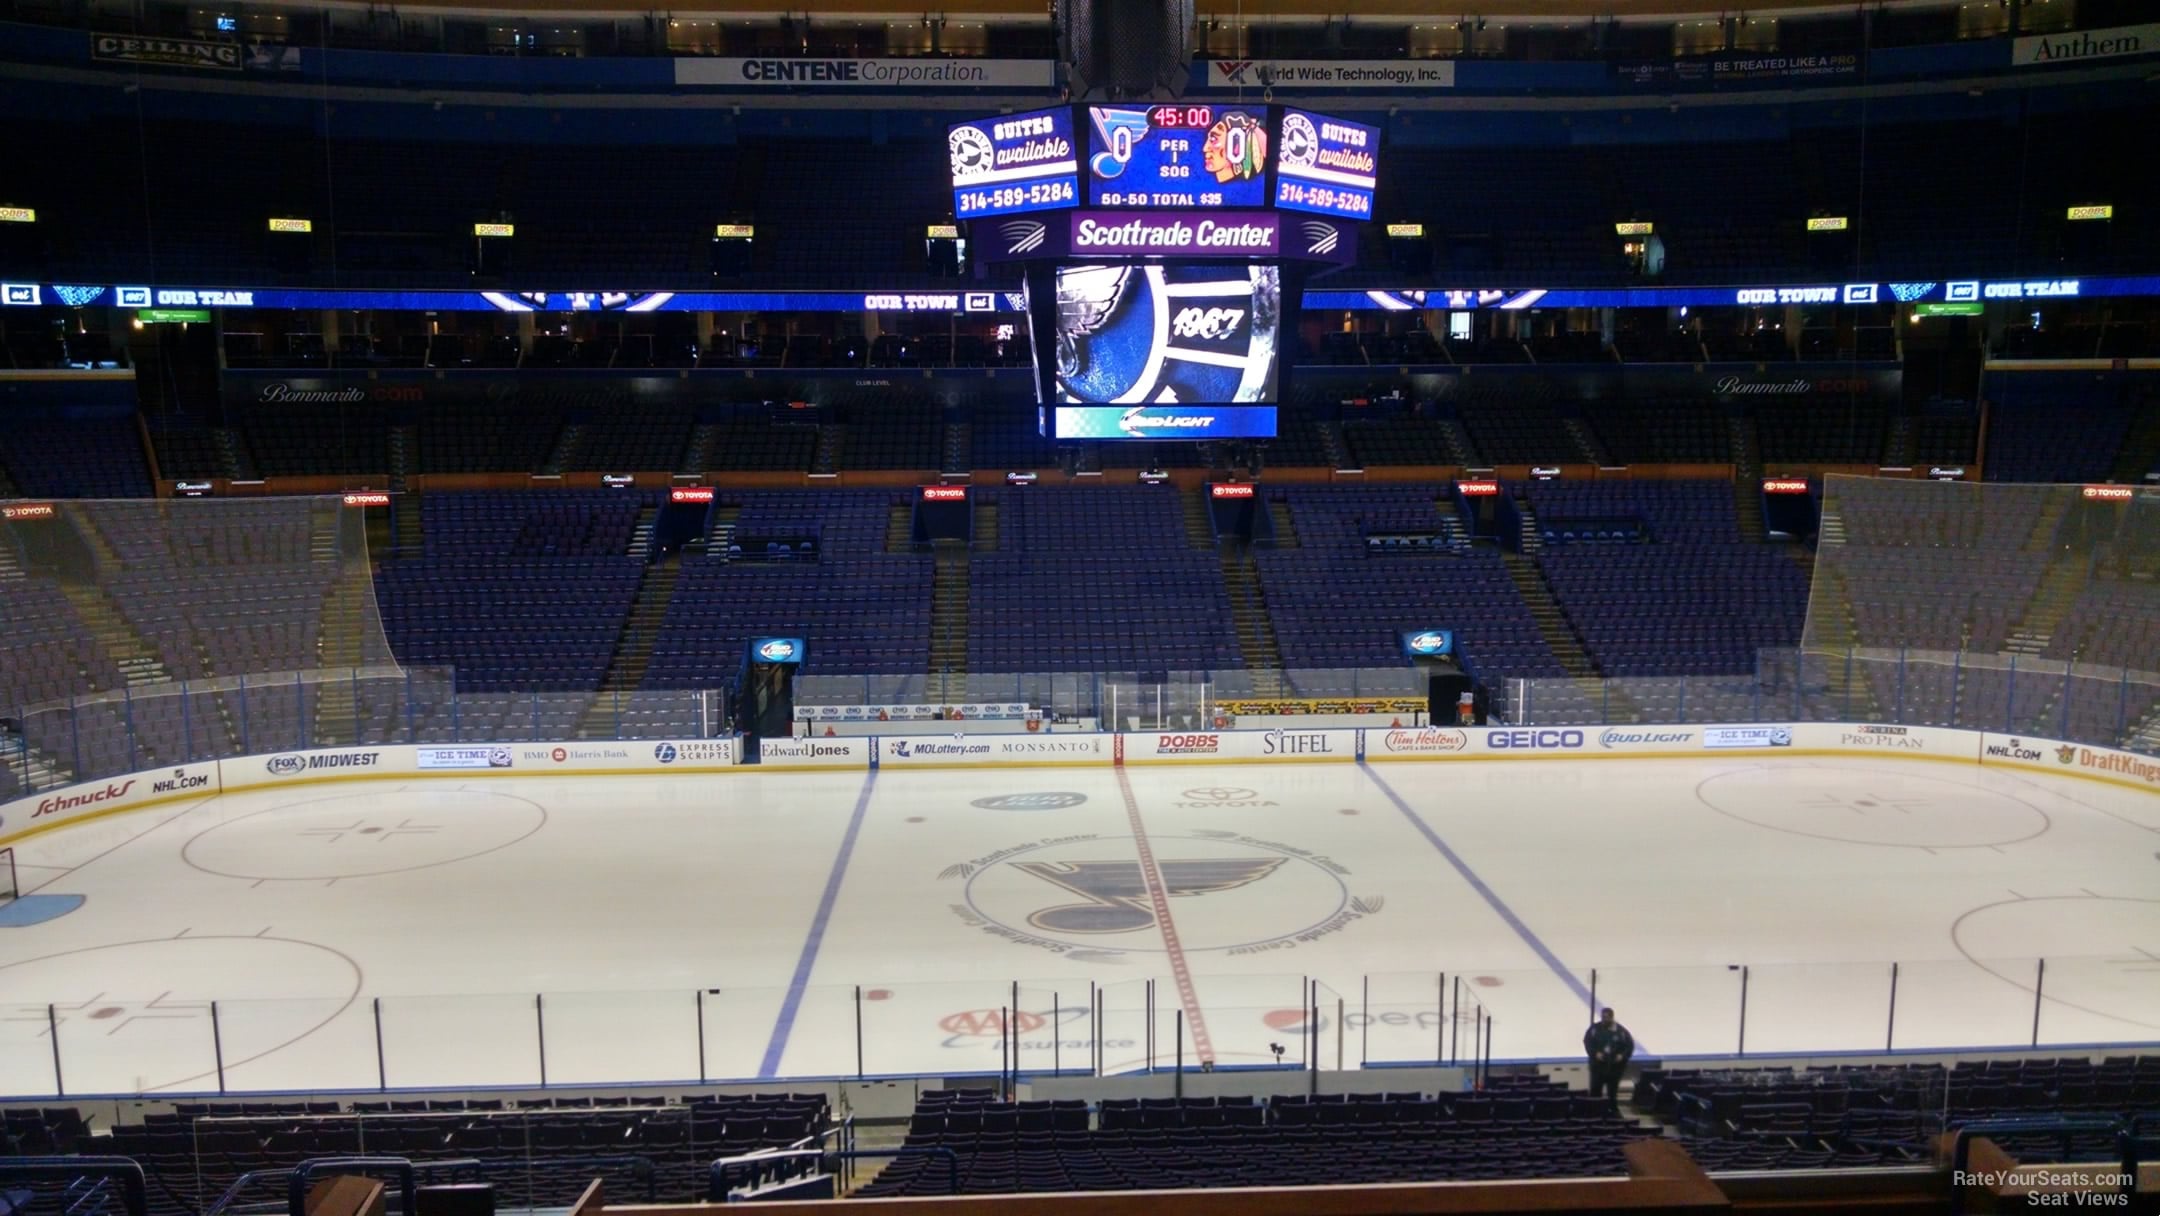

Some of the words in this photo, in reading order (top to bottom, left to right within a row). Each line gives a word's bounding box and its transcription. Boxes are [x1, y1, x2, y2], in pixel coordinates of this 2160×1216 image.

[97, 38, 237, 63] CEILING
[2033, 33, 2140, 61] Anthem
[1714, 62, 1729, 72] BE
[1733, 58, 1786, 71] TREATED
[1789, 57, 1816, 68] LIKE
[1818, 56, 1828, 66] A
[1830, 55, 1856, 66] PRO
[742, 59, 859, 81] CENTENE
[861, 60, 984, 85] Corporation
[1255, 66, 1294, 81] Wrld
[1300, 67, 1332, 81] Wide
[1335, 67, 1414, 83] Technology,
[1418, 67, 1441, 81] Inc.
[1154, 108, 1210, 126] 45:00
[994, 116, 1053, 140] SUITES
[1321, 122, 1367, 147] SUITES
[997, 137, 1070, 165] available
[1113, 126, 1132, 163] 0
[1160, 139, 1189, 151] PER
[1226, 127, 1246, 164] 0
[1318, 148, 1374, 172] available
[1159, 165, 1190, 177] SOG
[960, 182, 1073, 212] 314-589-5284
[1101, 193, 1148, 206] 50-50
[1152, 193, 1195, 205] TOTAL
[1199, 193, 1223, 205] $35
[1280, 182, 1369, 213] 314-589-5284
[0, 208, 29, 218] OBBS
[2072, 207, 2107, 217] DOBBS
[274, 220, 307, 229] DOBBS
[479, 225, 509, 233] DOBBS
[933, 226, 957, 234] DOBB
[1620, 224, 1648, 232] DOBBS
[1812, 218, 1842, 228] DOBBS
[1076, 218, 1193, 246] Scottrade
[1737, 289, 1777, 304] OUR
[1778, 288, 1837, 303] TOWN
[1985, 283, 2022, 297] OUR
[2023, 281, 2079, 296] TEAM
[158, 291, 198, 305] OUR
[198, 291, 253, 306] TEAM
[865, 295, 903, 310] OUR
[904, 295, 958, 310] TOWN
[1173, 307, 1245, 340] 1967
[260, 383, 366, 402] Bommarito
[1712, 376, 1811, 394] Bommarito
[1163, 415, 1215, 427] LIGHT
[1775, 482, 1806, 490] TOYOTA
[2097, 489, 2132, 497] TOYOTA
[684, 491, 713, 499] TOYOTA
[16, 507, 53, 516] TOYOTA
[1159, 735, 1219, 748] DOBBS
[1392, 731, 1413, 745] Tim
[1415, 731, 1459, 745] Hortons
[1606, 733, 1641, 743] BUD
[1644, 733, 1694, 743] LIGHT
[1720, 730, 1740, 738] ICE
[1742, 730, 1769, 738] TIME
[680, 743, 729, 751] EXPRESS
[914, 743, 990, 755] MOLottery.com
[1001, 743, 1089, 752] MONSANTO
[1264, 732, 1333, 754] STIFEL
[435, 751, 454, 760] ICE
[458, 750, 487, 759] TIME
[523, 751, 549, 759] BMO
[570, 750, 598, 759] Harris
[603, 750, 629, 759] Bank
[680, 751, 730, 760] SCRIPTS
[1986, 745, 2042, 760] NHL.COM
[274, 757, 299, 768] FOX
[309, 753, 379, 769] MIDWEST
[153, 775, 208, 793] NHL.COM
[31, 779, 137, 819] Schnucks
[1172, 800, 1280, 808] TOYOTA
[970, 842, 1038, 866] Scottrade
[1040, 833, 1098, 844] Center
[952, 1010, 1037, 1034] AAA
[1344, 1010, 1493, 1031] peps
